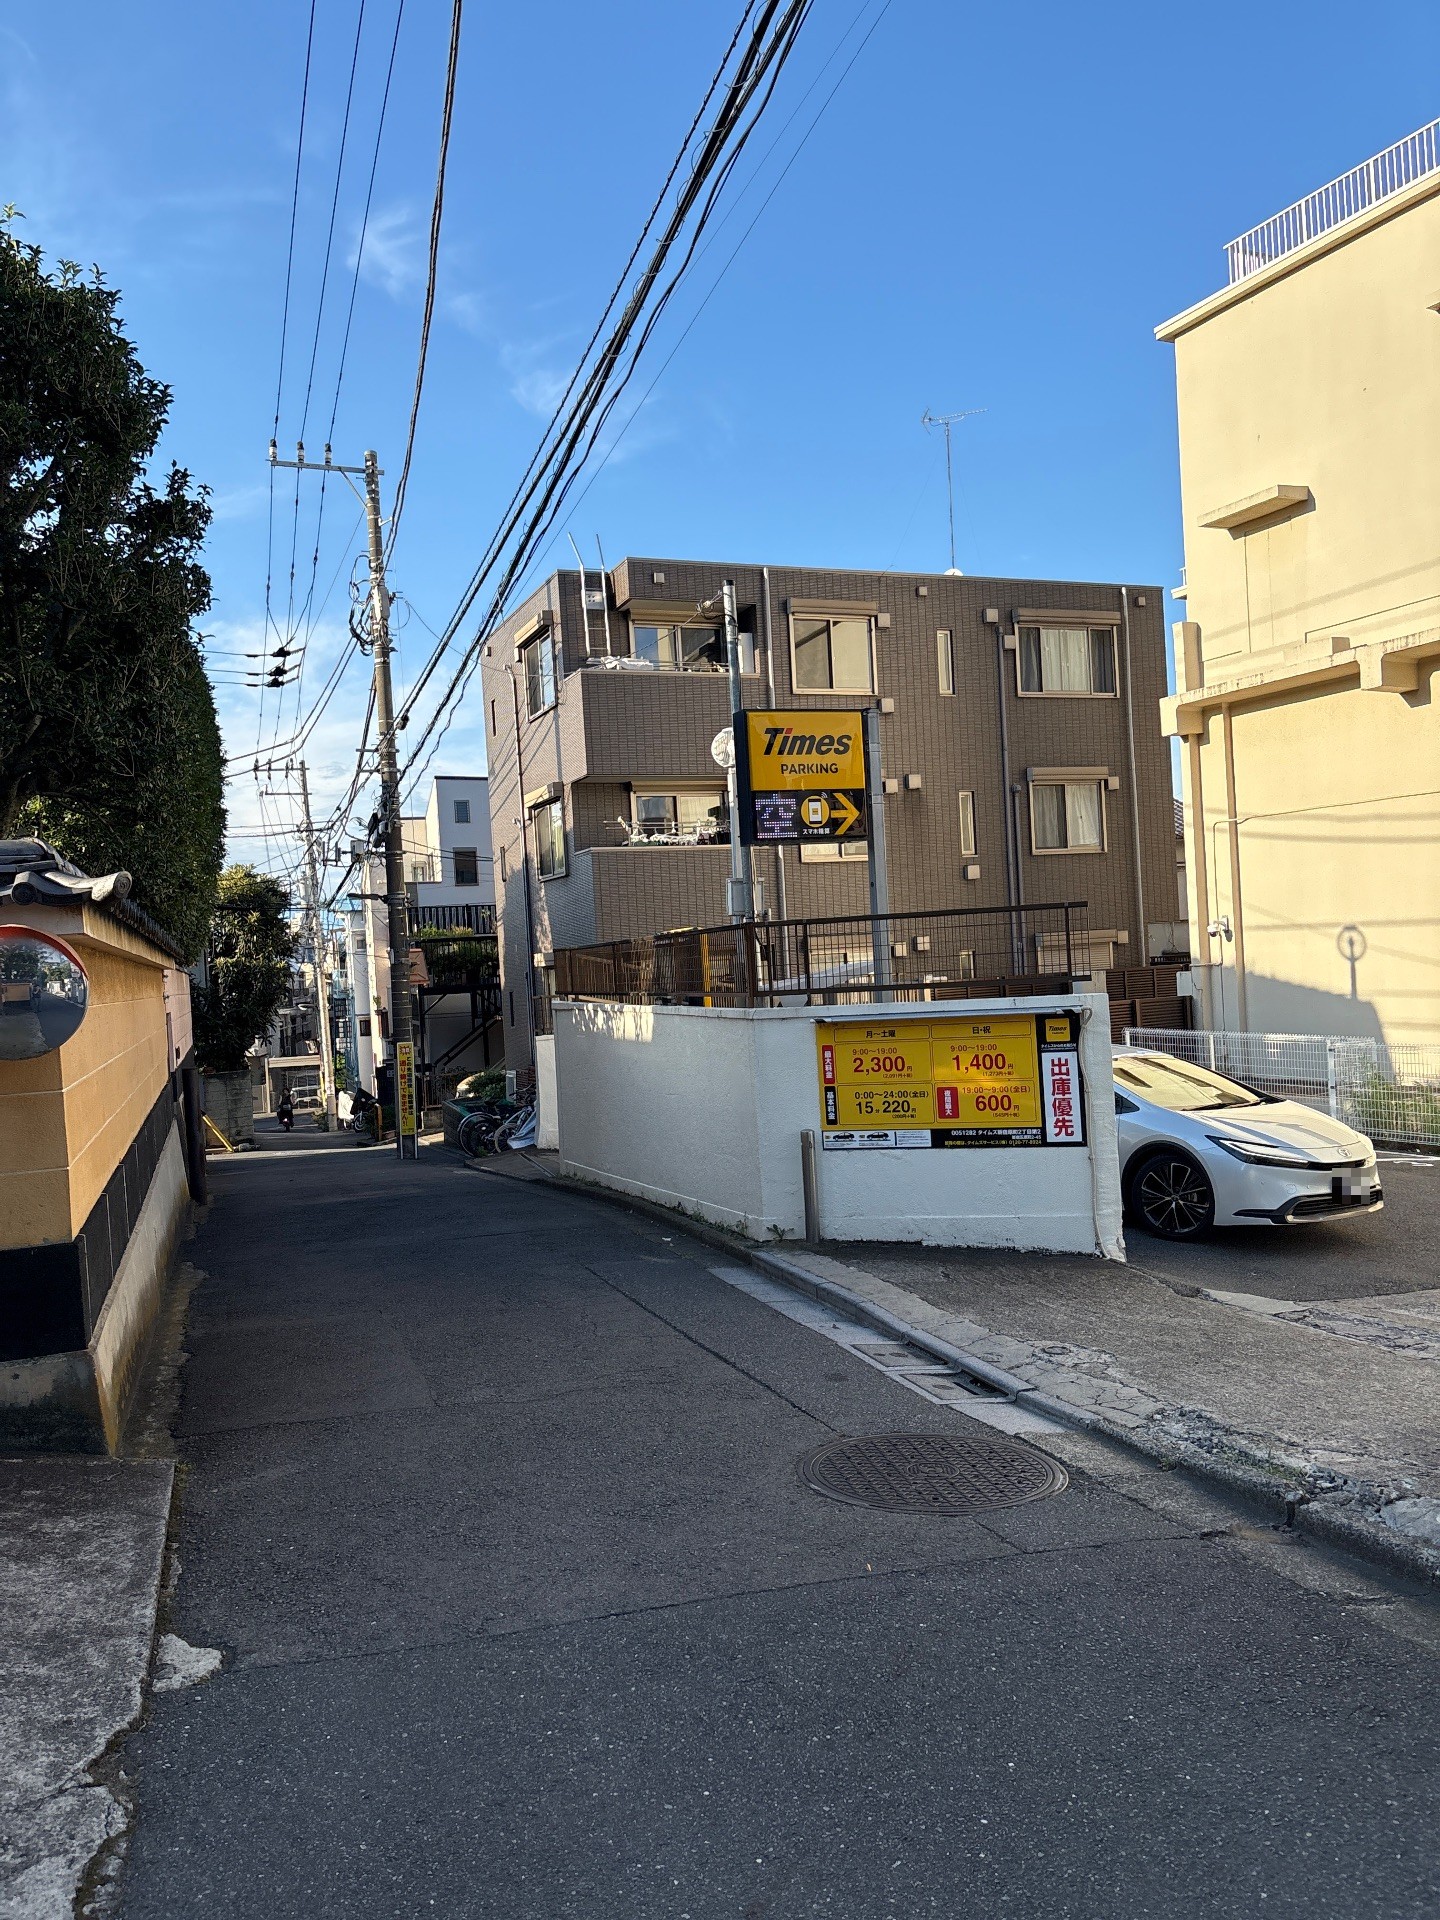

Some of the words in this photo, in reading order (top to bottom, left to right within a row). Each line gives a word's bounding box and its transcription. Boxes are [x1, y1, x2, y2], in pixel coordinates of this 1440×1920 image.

[763, 728, 852, 755] Times
[781, 763, 839, 775] PARKING
[755, 793, 798, 839] 空
[824, 1050, 833, 1079] 最大料金
[827, 1091, 836, 1120] 基本料金
[1050, 1057, 1075, 1137] 出庫優先
